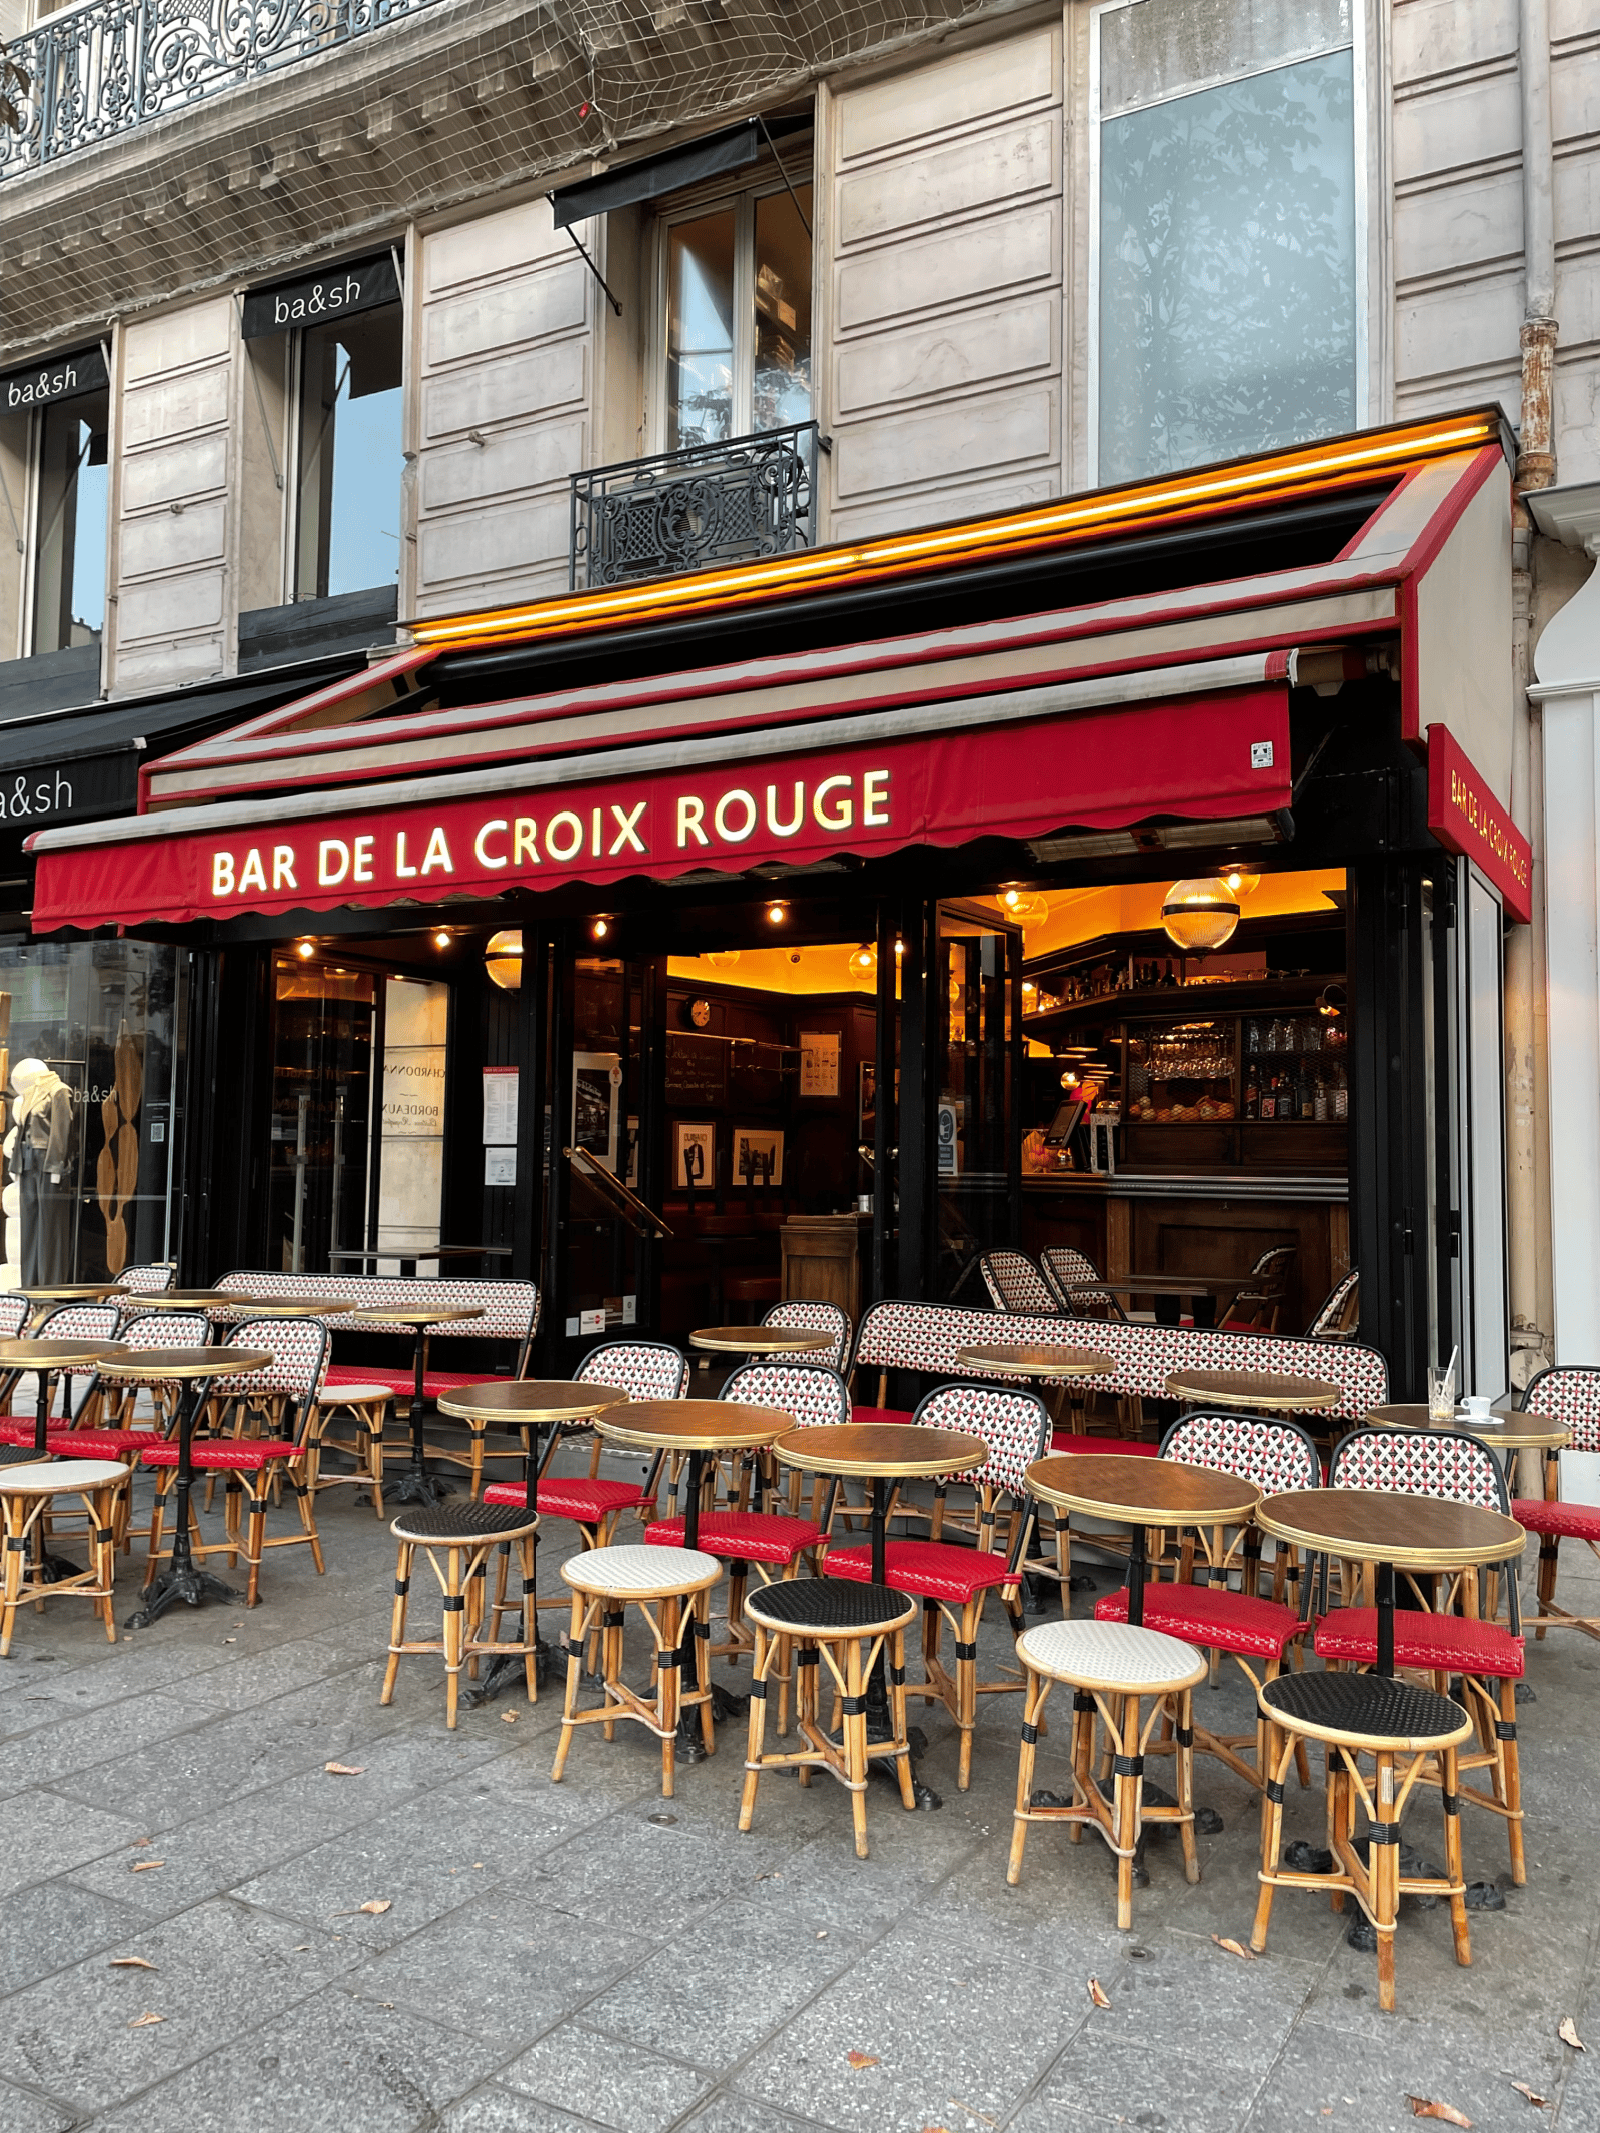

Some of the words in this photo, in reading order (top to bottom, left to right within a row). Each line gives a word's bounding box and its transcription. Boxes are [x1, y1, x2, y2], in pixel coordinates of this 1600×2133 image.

[274, 275, 361, 324] ba&sh
[8, 364, 77, 407] ba&sh
[1451, 769, 1468, 816] BAR
[1468, 790, 1478, 829] DE
[1479, 804, 1488, 841] LA
[211, 845, 299, 897] BAR
[318, 835, 375, 886] DE
[396, 827, 454, 877] LA
[474, 801, 648, 869] CROIX
[676, 769, 890, 848] ROUGE
[73, 1084, 118, 1103] ba&sh
